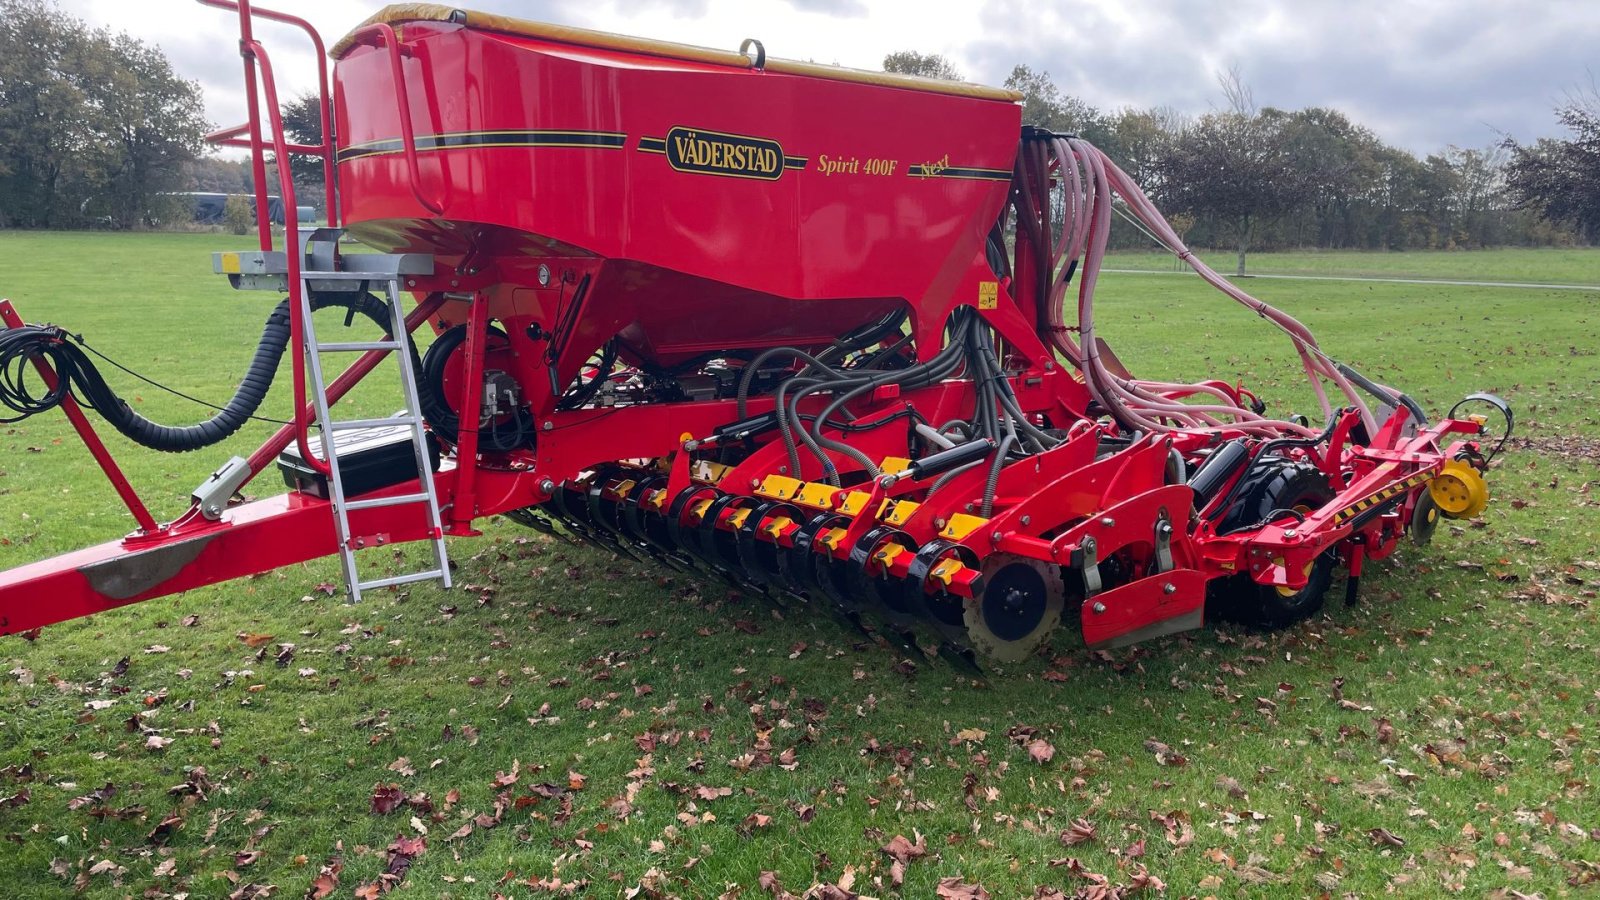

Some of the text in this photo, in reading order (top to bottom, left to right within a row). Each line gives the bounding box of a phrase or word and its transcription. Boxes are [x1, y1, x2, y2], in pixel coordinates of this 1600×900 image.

[674, 132, 778, 173] VÄDERSTAD
[817, 154, 898, 176] Spirit 400F
[920, 154, 950, 180] Next
